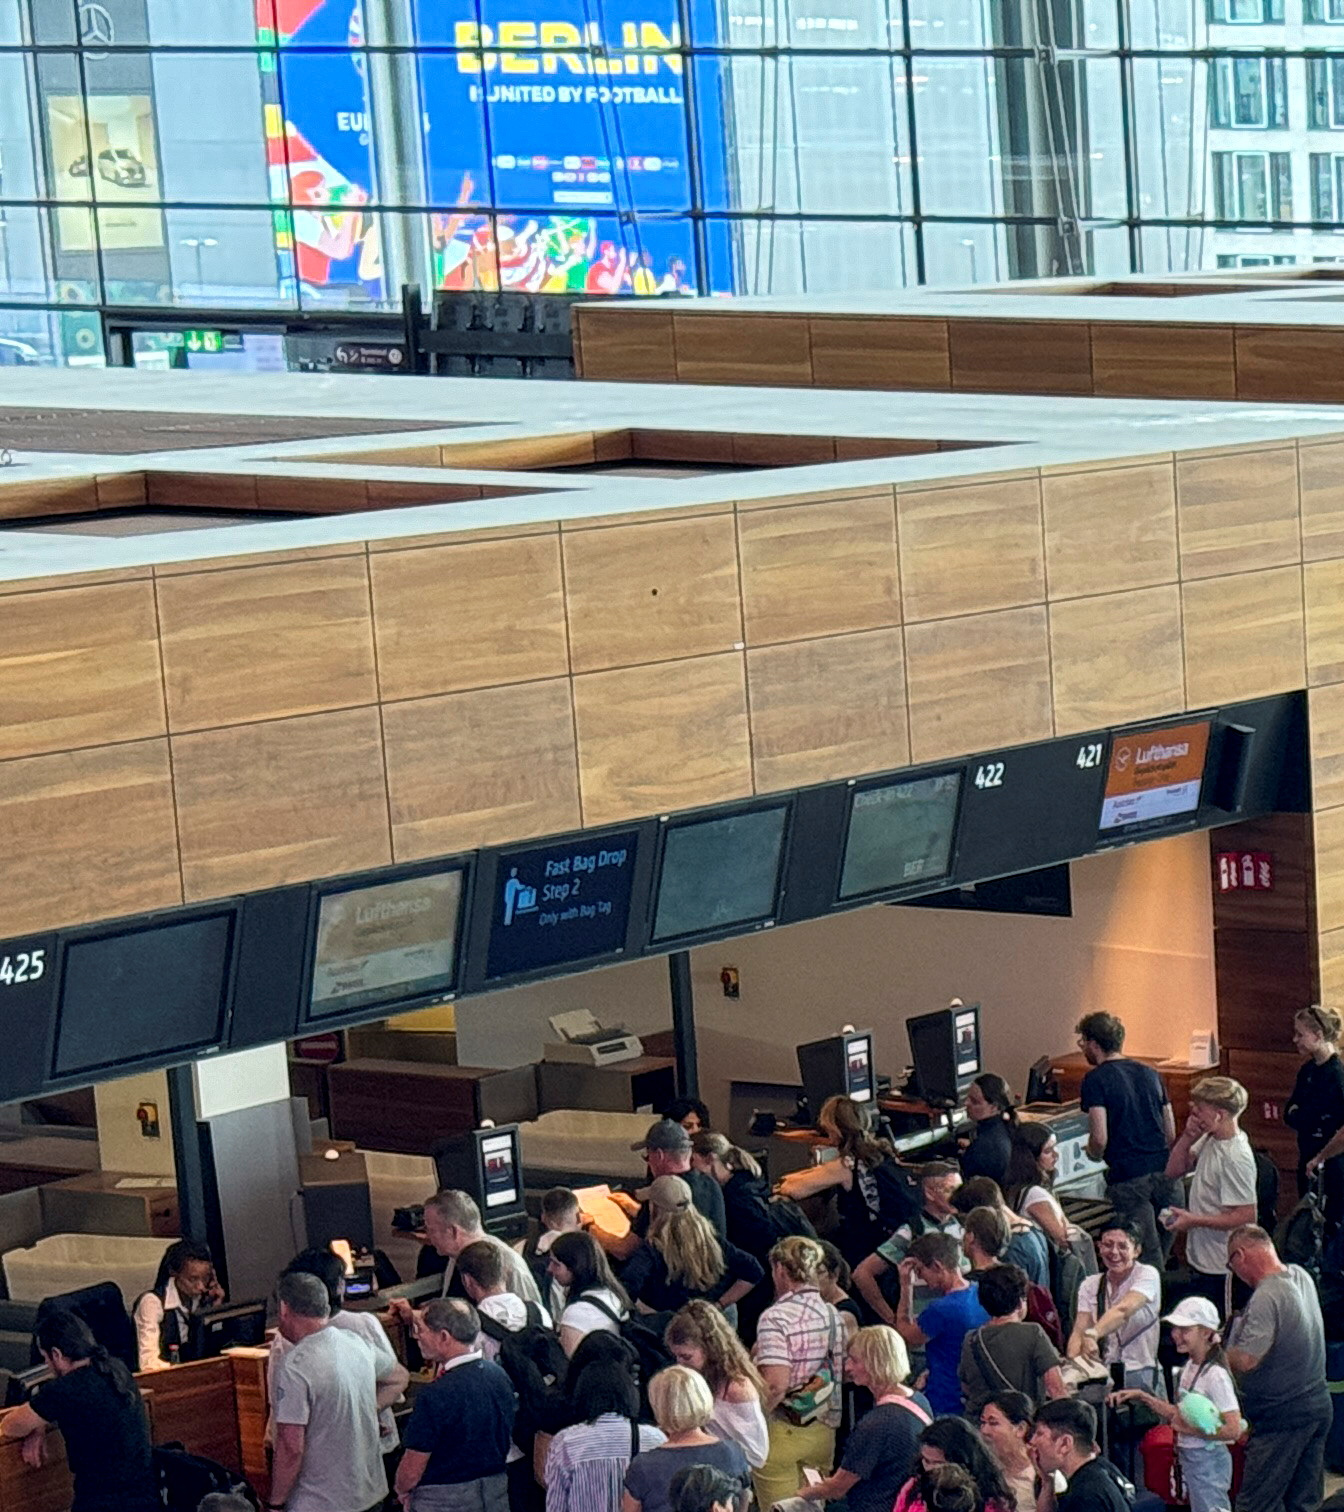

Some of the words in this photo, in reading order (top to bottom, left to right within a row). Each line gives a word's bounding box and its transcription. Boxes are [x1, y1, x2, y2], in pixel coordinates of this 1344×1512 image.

[453, 20, 684, 75] BERLIN
[558, 86, 582, 103] BY
[584, 86, 684, 104] FOOTBALL
[1076, 743, 1103, 769] 421
[1135, 742, 1190, 765] Lufthansa
[975, 762, 1005, 790] 422
[545, 860, 571, 878] Fast
[572, 854, 597, 875] Bag
[598, 849, 628, 869] Drop
[542, 881, 571, 902] Step
[571, 878, 581, 896] 2
[538, 910, 560, 926] Only
[560, 906, 579, 922] with
[579, 903, 597, 918] Bag
[597, 900, 613, 917] Tag
[0, 949, 45, 985] 425
